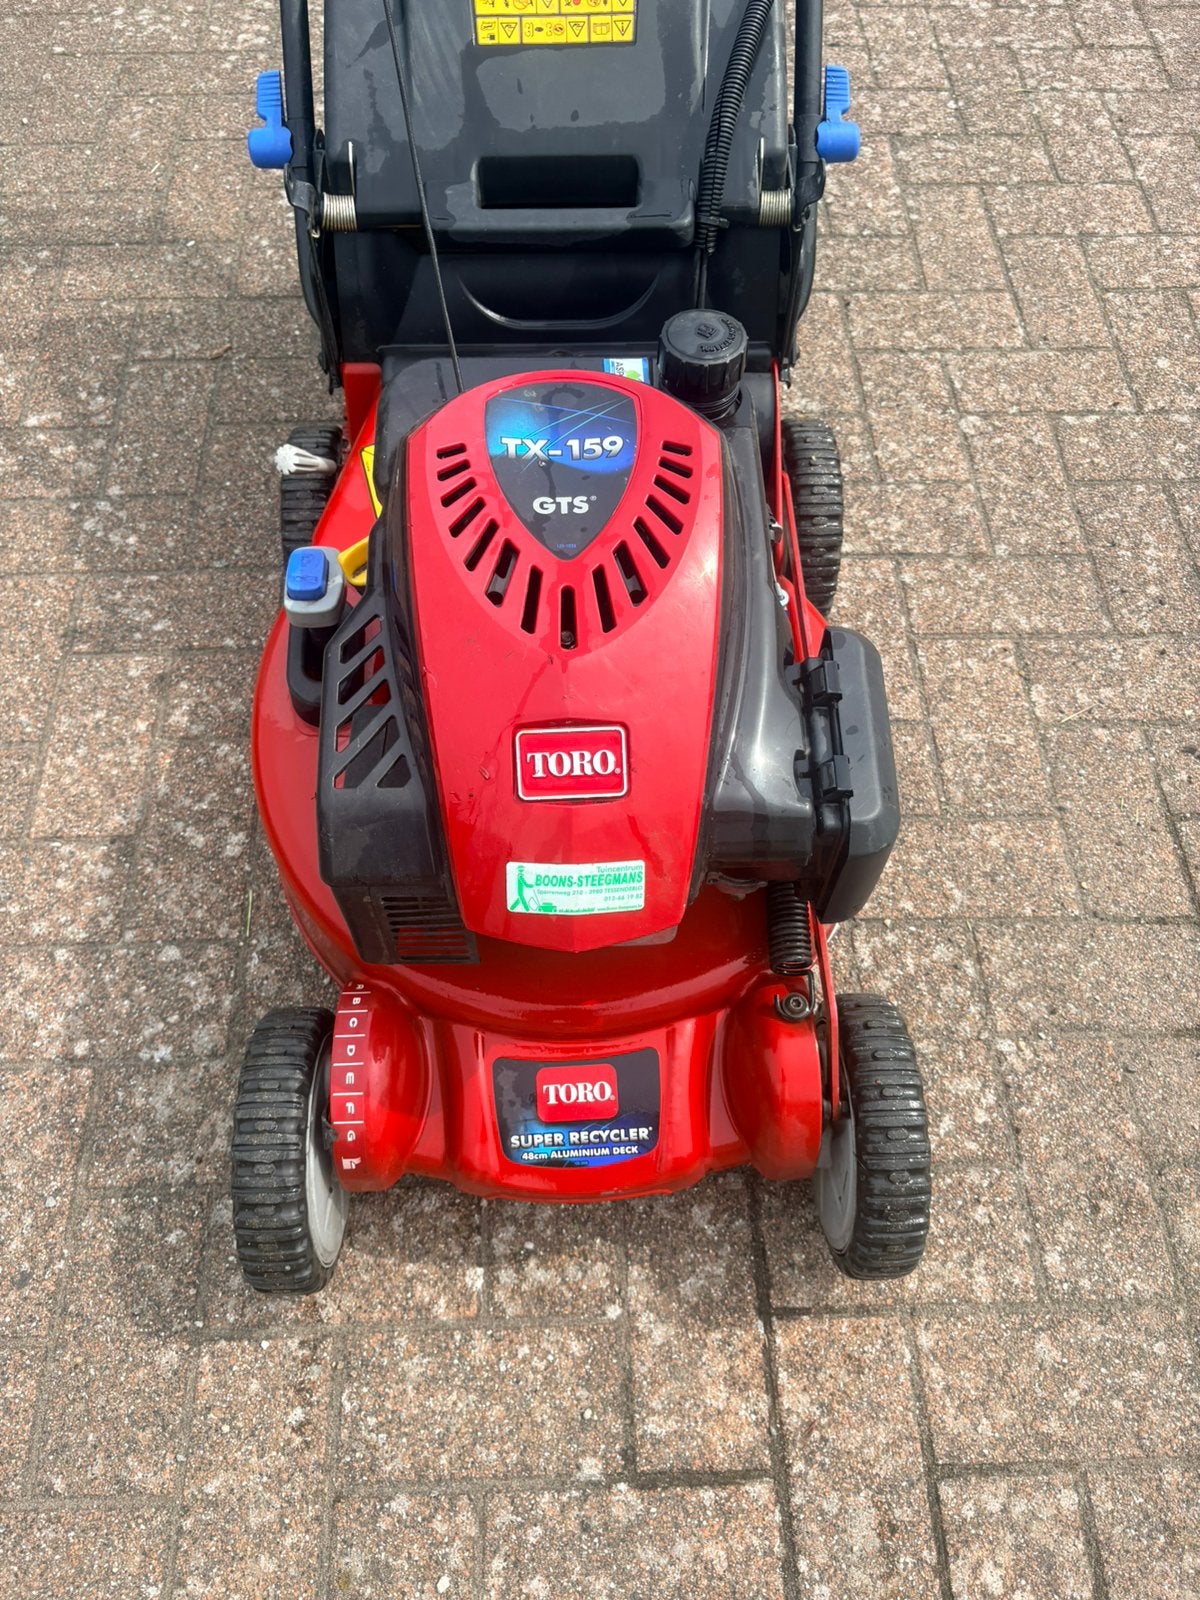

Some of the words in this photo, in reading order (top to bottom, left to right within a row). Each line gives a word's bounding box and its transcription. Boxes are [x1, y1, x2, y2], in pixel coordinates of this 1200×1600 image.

[615, 362, 625, 376] ASP
[500, 435, 624, 461] TX-159
[596, 864, 643, 874] Tuincentrum
[535, 871, 643, 888] BOONS-STEEGMANS
[352, 997, 361, 1005] B
[349, 1017, 358, 1028] C
[347, 1045, 356, 1056] D
[345, 1072, 355, 1085] E
[345, 1101, 355, 1114] F
[347, 1130, 356, 1141] G
[510, 1132, 564, 1149] SUPER
[521, 1151, 548, 1161] 48cm
[550, 1147, 610, 1159] ALUMINIUM
[612, 1145, 639, 1155] DECK
